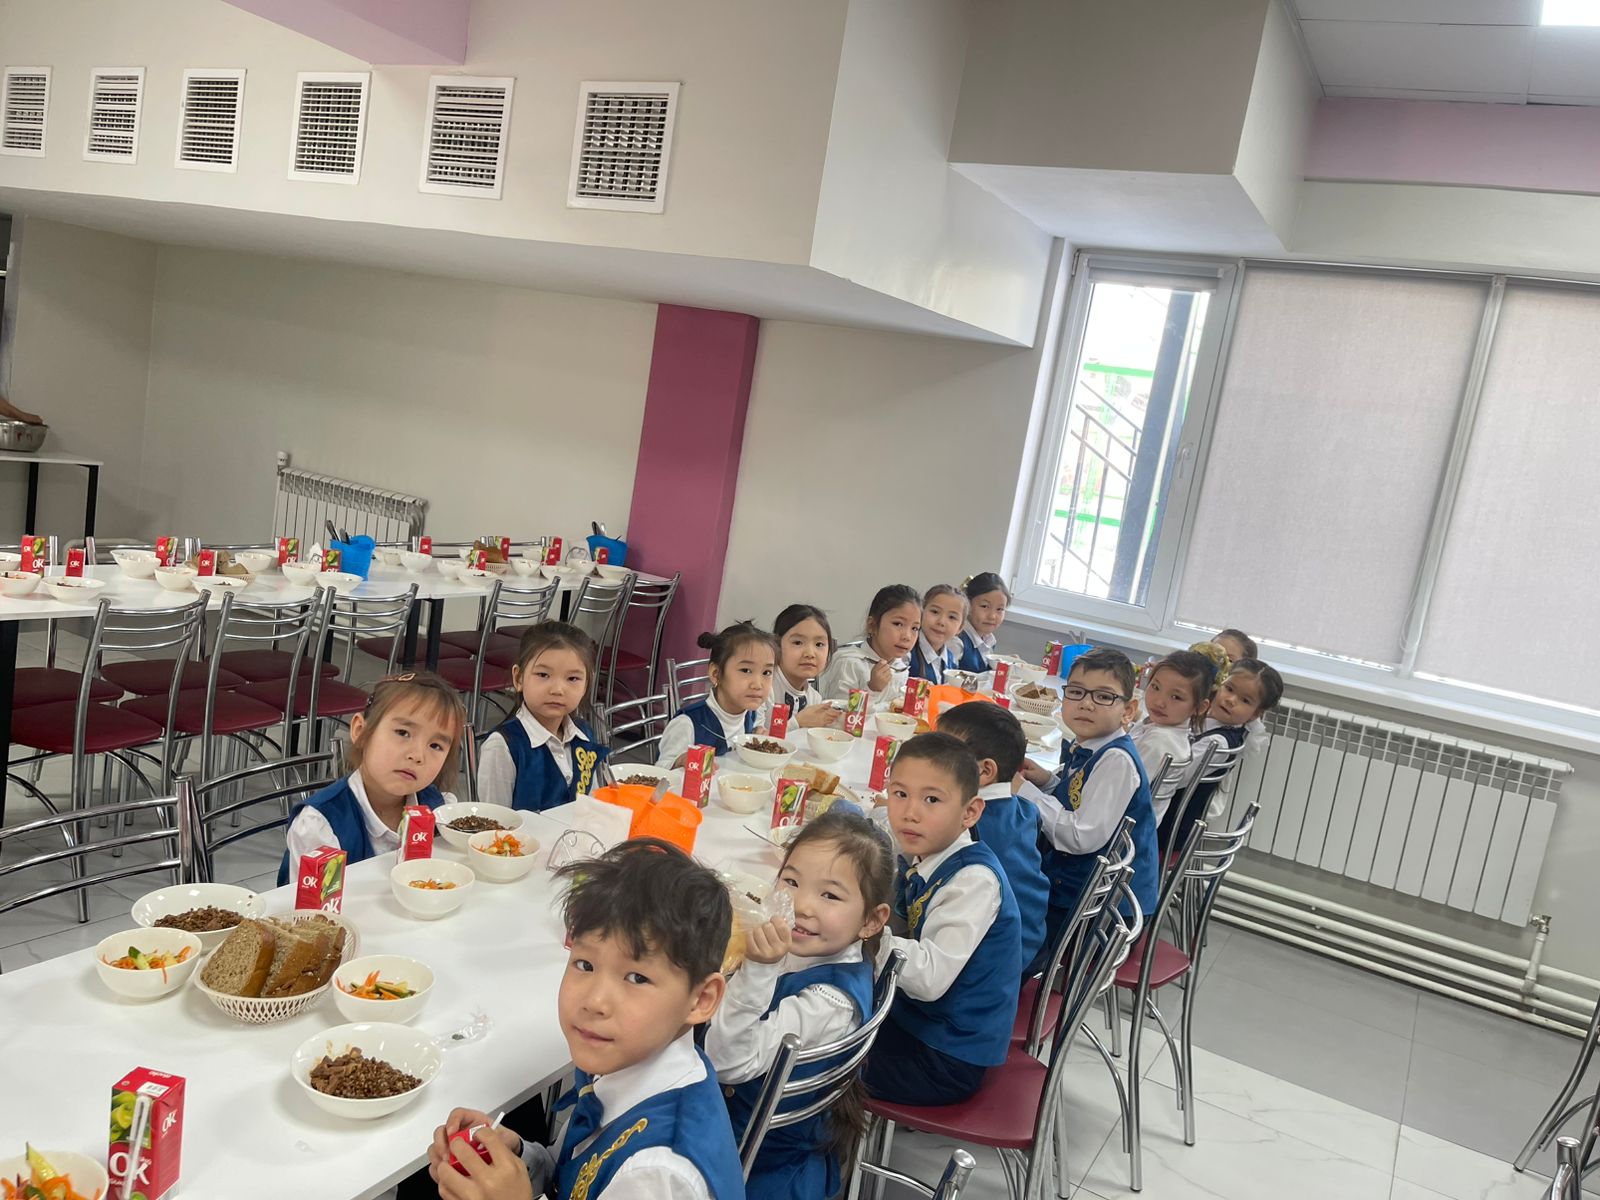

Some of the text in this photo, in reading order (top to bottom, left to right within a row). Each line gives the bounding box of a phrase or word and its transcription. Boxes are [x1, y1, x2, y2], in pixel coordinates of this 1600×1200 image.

[33, 558, 44, 569] OK
[847, 714, 864, 726] OK
[412, 831, 428, 843] OK
[303, 875, 319, 889] OK
[162, 1109, 178, 1133] OK
[109, 1151, 151, 1186] OK
